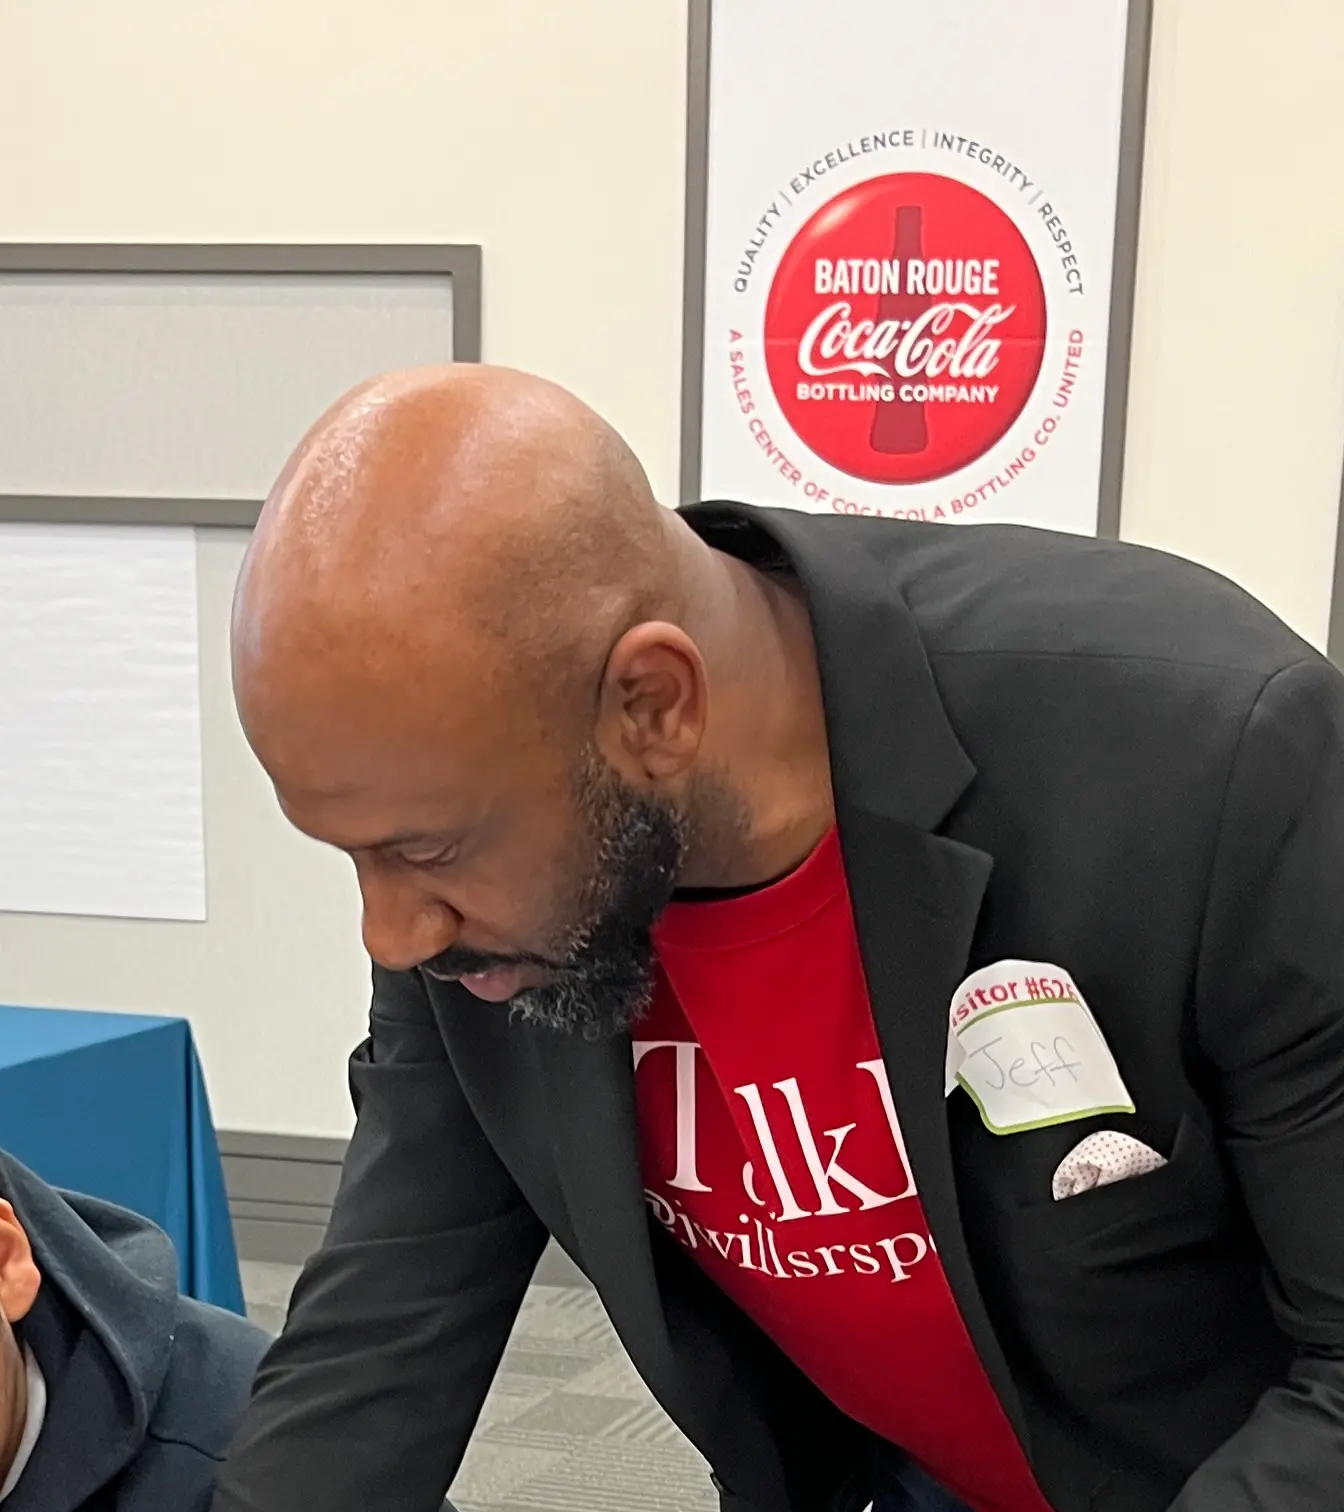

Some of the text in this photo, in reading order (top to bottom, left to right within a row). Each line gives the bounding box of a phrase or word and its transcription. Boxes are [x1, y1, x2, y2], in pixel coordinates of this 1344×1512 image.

[734, 129, 1084, 296] QUALITY EXCELLENCE INTEGRITY RESPECT
[814, 258, 999, 296] BATON ROUGE
[729, 329, 743, 343] A
[798, 302, 1017, 379] Coca-Cola
[729, 350, 755, 414] SALES
[796, 383, 999, 404] BOTTLING COMPANY
[1052, 328, 1084, 409] UNITED
[749, 418, 802, 486] CENTER
[1034, 416, 1061, 446] CO.
[803, 482, 830, 502] OF
[949, 448, 1035, 515] BOTTLING
[952, 981, 1018, 1028] sitor
[968, 1036, 1082, 1091] Jeff
